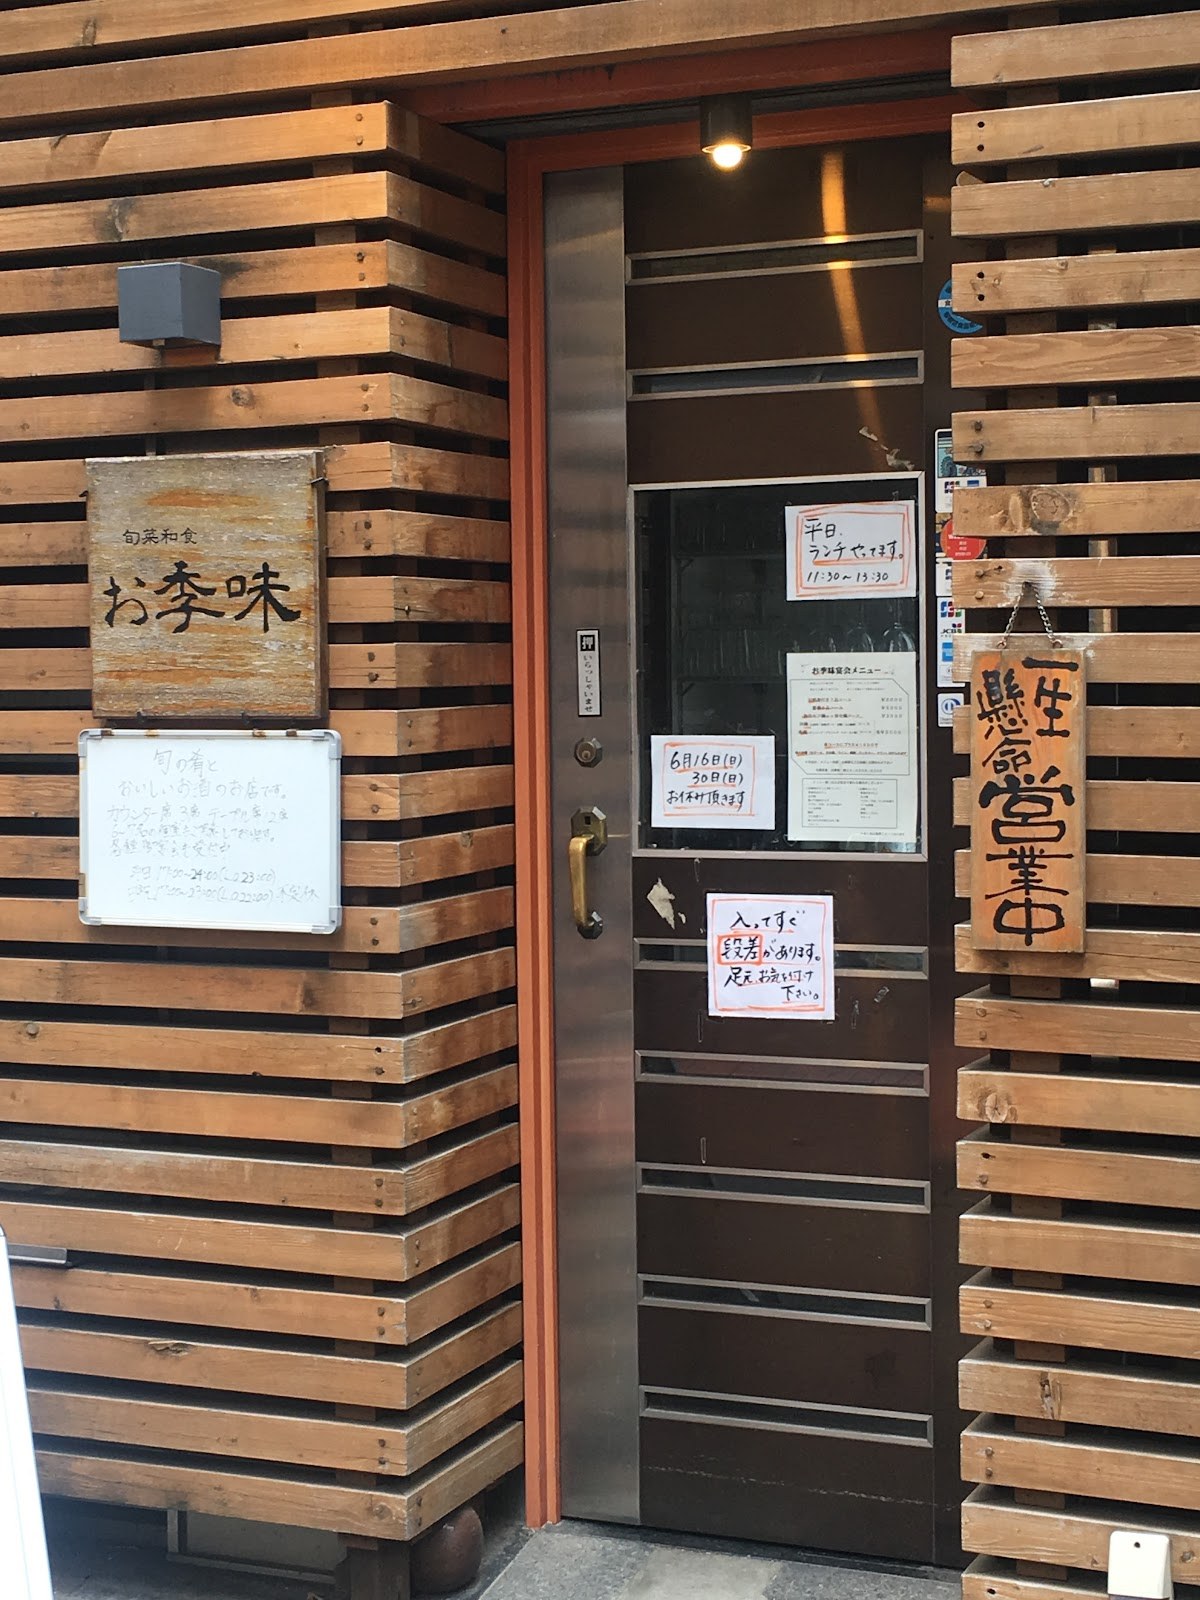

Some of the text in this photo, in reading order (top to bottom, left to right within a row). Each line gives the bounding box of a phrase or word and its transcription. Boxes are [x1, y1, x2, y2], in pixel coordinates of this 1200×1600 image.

[122, 527, 198, 546] 旬菜和食
[809, 540, 904, 562] ランチやってます。
[103, 560, 302, 634] お季味
[583, 654, 594, 713] いらっしゃいませ
[670, 751, 743, 770] 6月16日(日)
[692, 771, 744, 785] 30日(日)
[666, 789, 746, 812] お休み頂きます
[978, 766, 1075, 947] 営業中
[729, 910, 806, 934] 入ってすぐ
[721, 936, 822, 964] 段差があります。
[780, 984, 820, 1002] 下さい。
